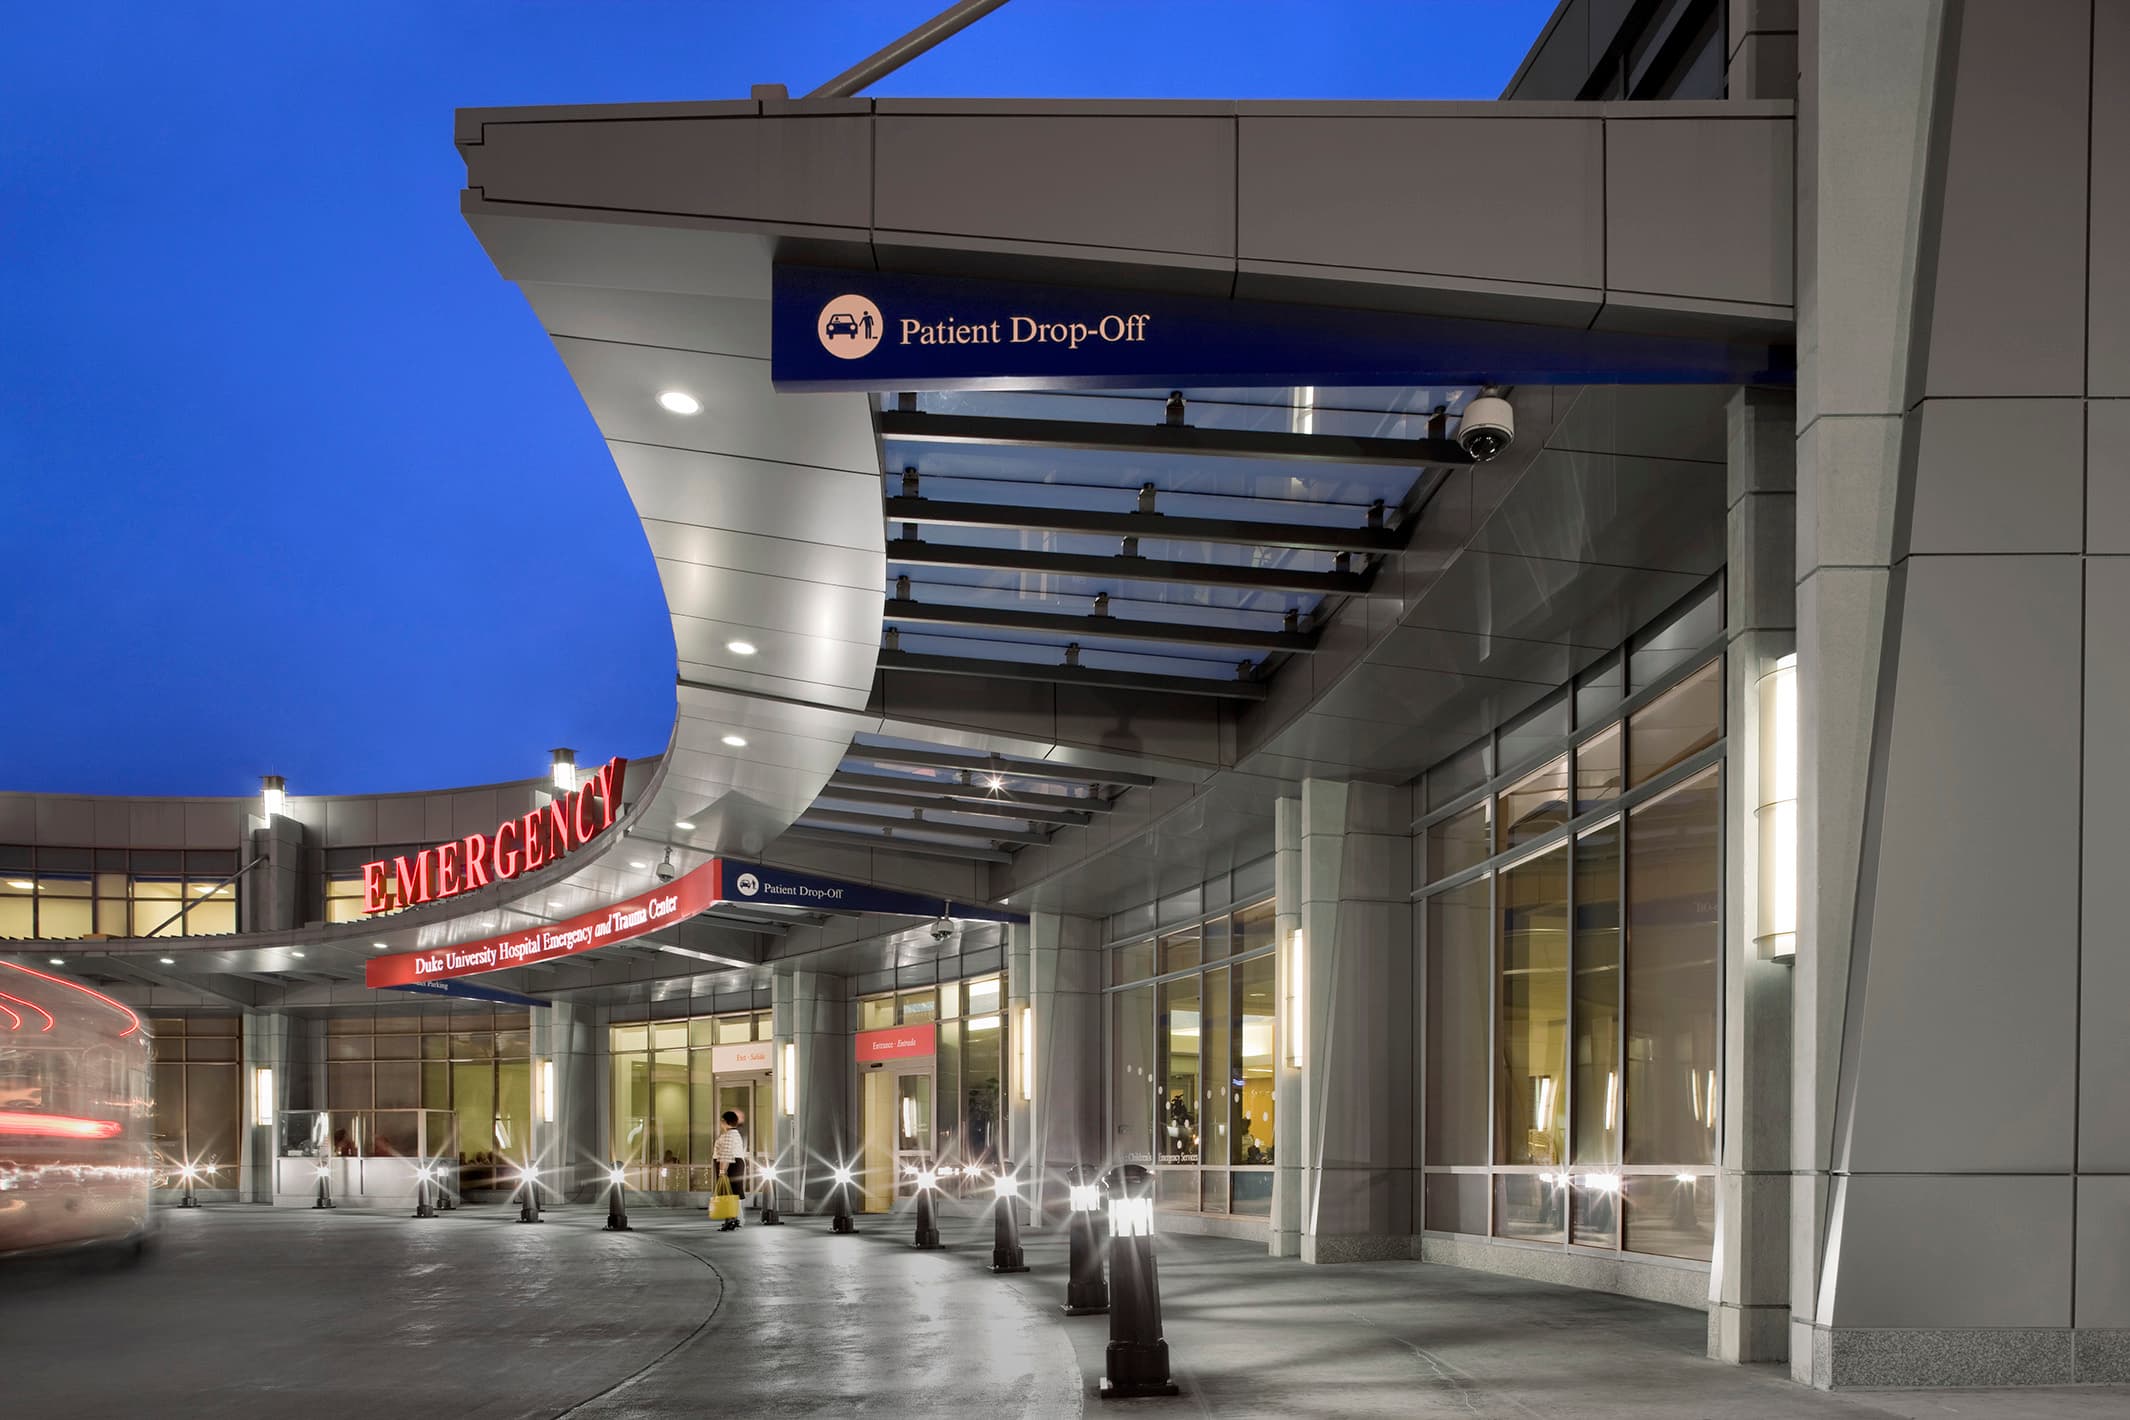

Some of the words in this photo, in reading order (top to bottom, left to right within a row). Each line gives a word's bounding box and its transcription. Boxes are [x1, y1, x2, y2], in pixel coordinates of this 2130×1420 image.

[900, 317, 1000, 345] Patient
[1009, 314, 1150, 349] Drop-Off
[361, 756, 627, 913] EMERGENCY
[764, 883, 797, 896] Patient
[800, 886, 843, 900] Drop-Off
[415, 956, 443, 974] Duke
[446, 949, 496, 967] University
[499, 933, 540, 960] Hospital
[543, 926, 592, 950] Emergency
[594, 914, 612, 937] and
[613, 909, 648, 932] Trauma
[649, 895, 678, 919] Center
